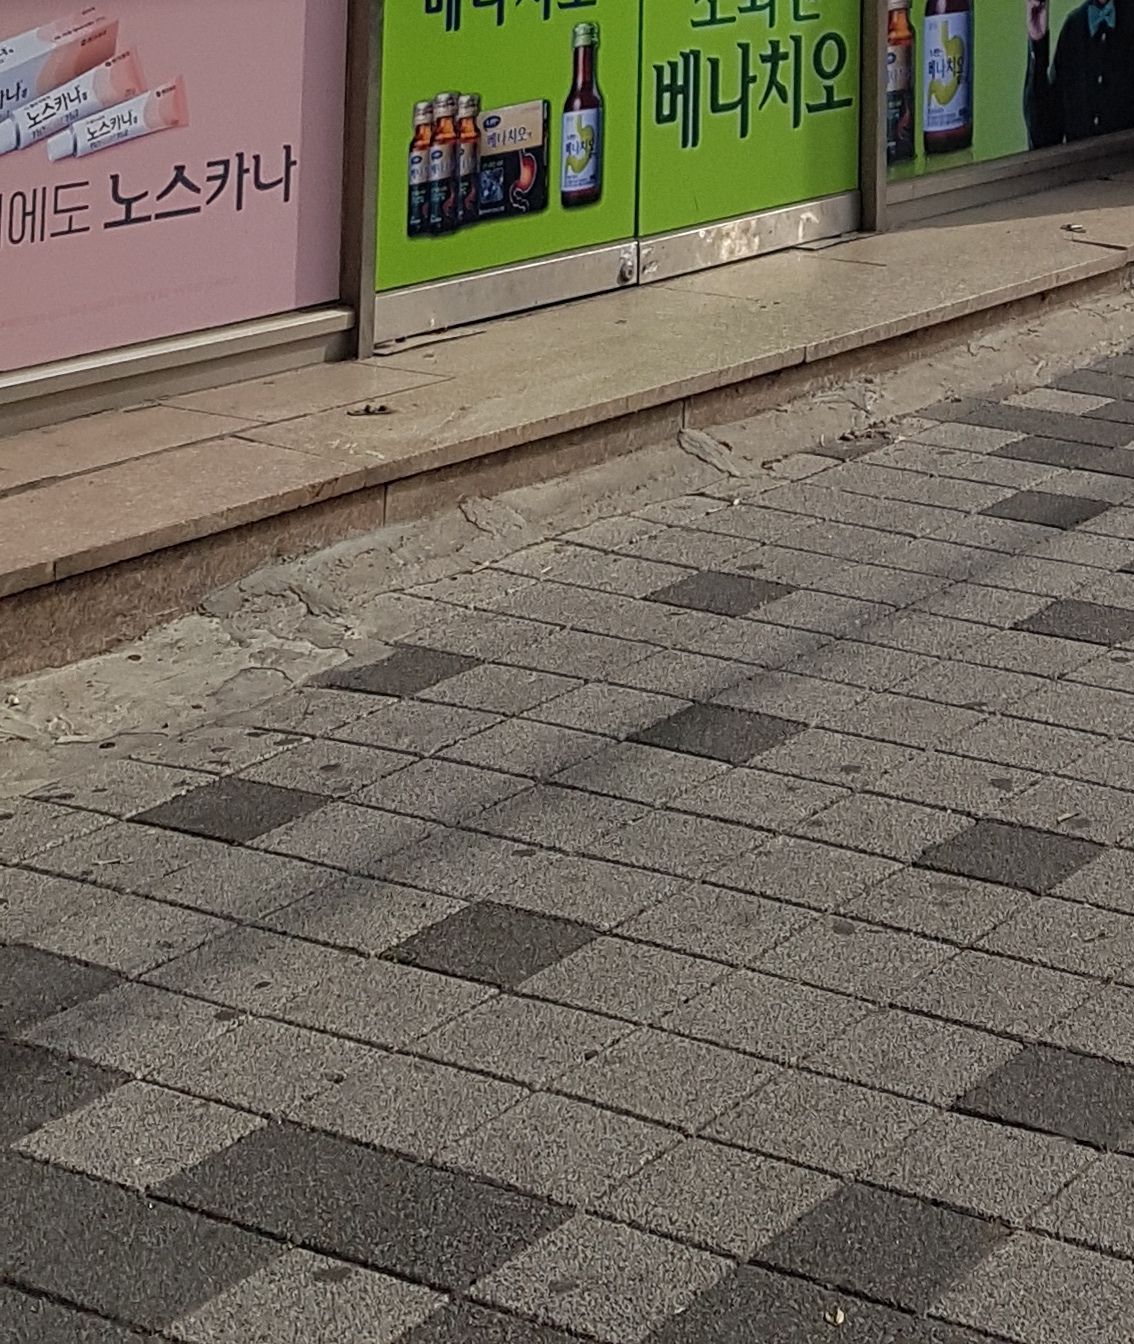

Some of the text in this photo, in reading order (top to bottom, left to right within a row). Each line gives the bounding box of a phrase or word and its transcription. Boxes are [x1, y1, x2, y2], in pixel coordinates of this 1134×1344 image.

[26, 83, 82, 130] 노스카나
[86, 110, 134, 143] 노스카나
[652, 31, 854, 149] 베나치오
[0, 144, 298, 245] 에도 노스카나
